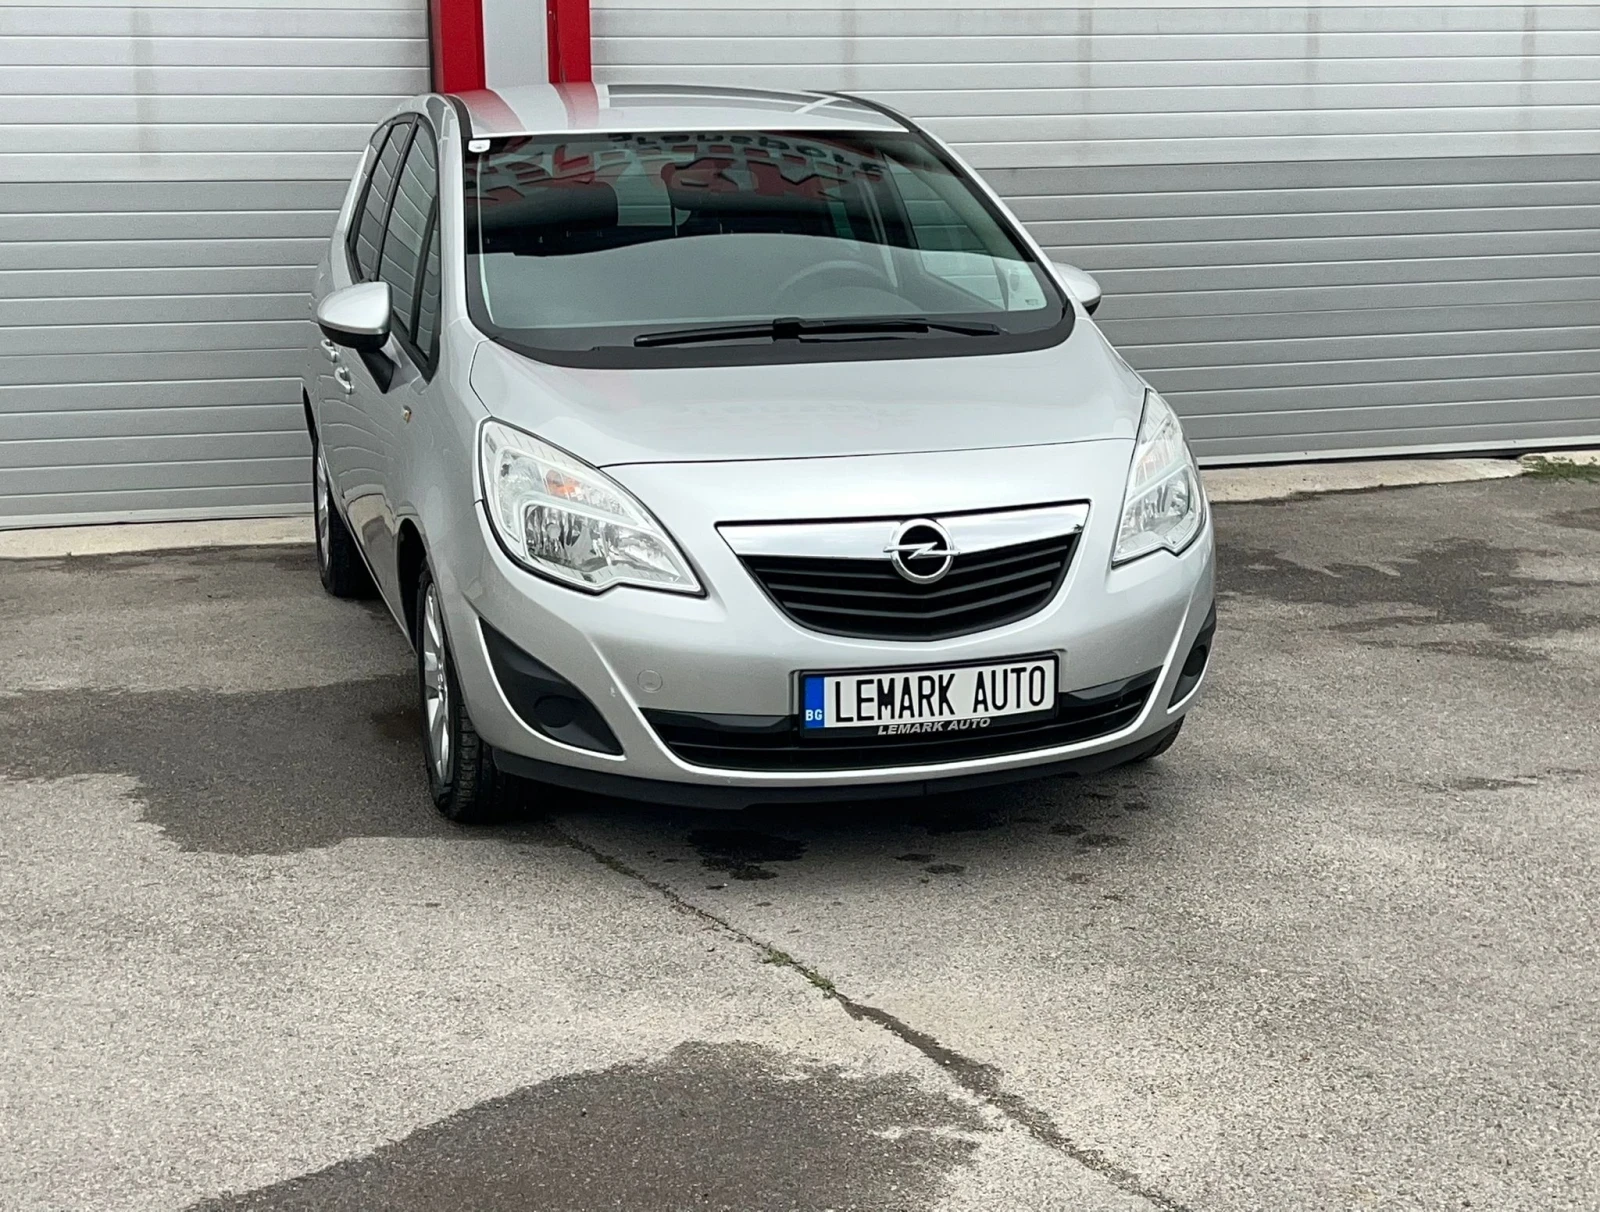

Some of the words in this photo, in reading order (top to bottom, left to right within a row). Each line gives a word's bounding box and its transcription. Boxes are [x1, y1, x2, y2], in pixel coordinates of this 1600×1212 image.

[835, 673, 955, 722] LEMARK
[973, 665, 1046, 713] AUTO
[805, 709, 823, 721] BG
[877, 721, 943, 735] LEMARK
[947, 718, 991, 731] AUTO
